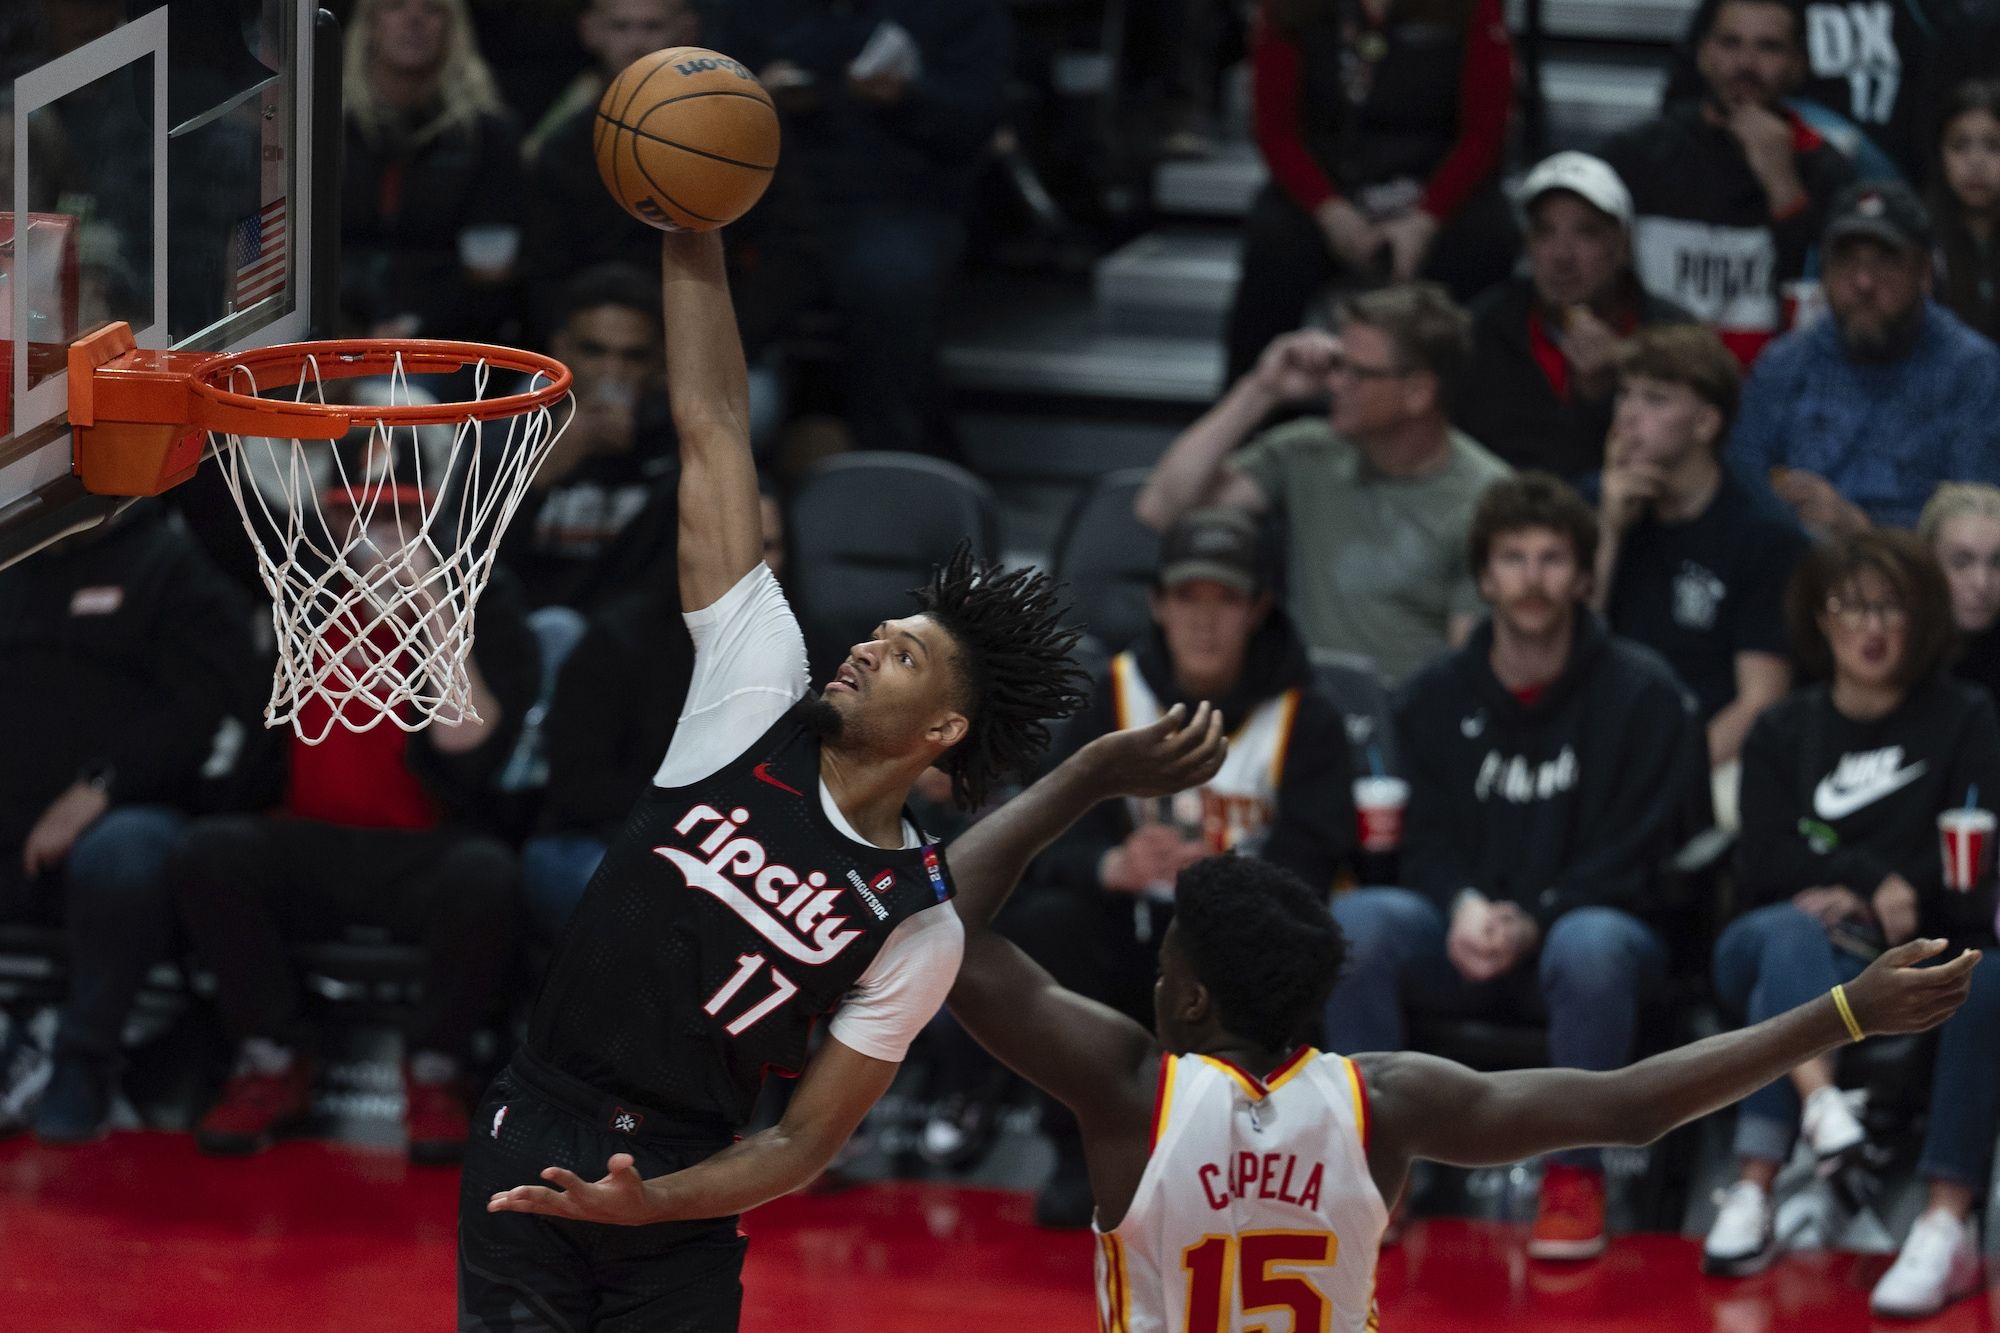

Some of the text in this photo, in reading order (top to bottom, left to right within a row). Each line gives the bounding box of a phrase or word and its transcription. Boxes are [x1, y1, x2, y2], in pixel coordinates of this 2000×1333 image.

[846, 869, 890, 921] BRIGHTSIDE
[875, 875, 893, 890] B
[927, 864, 942, 882] 32
[703, 952, 799, 1037] 17
[1181, 1228, 1339, 1333] 15
